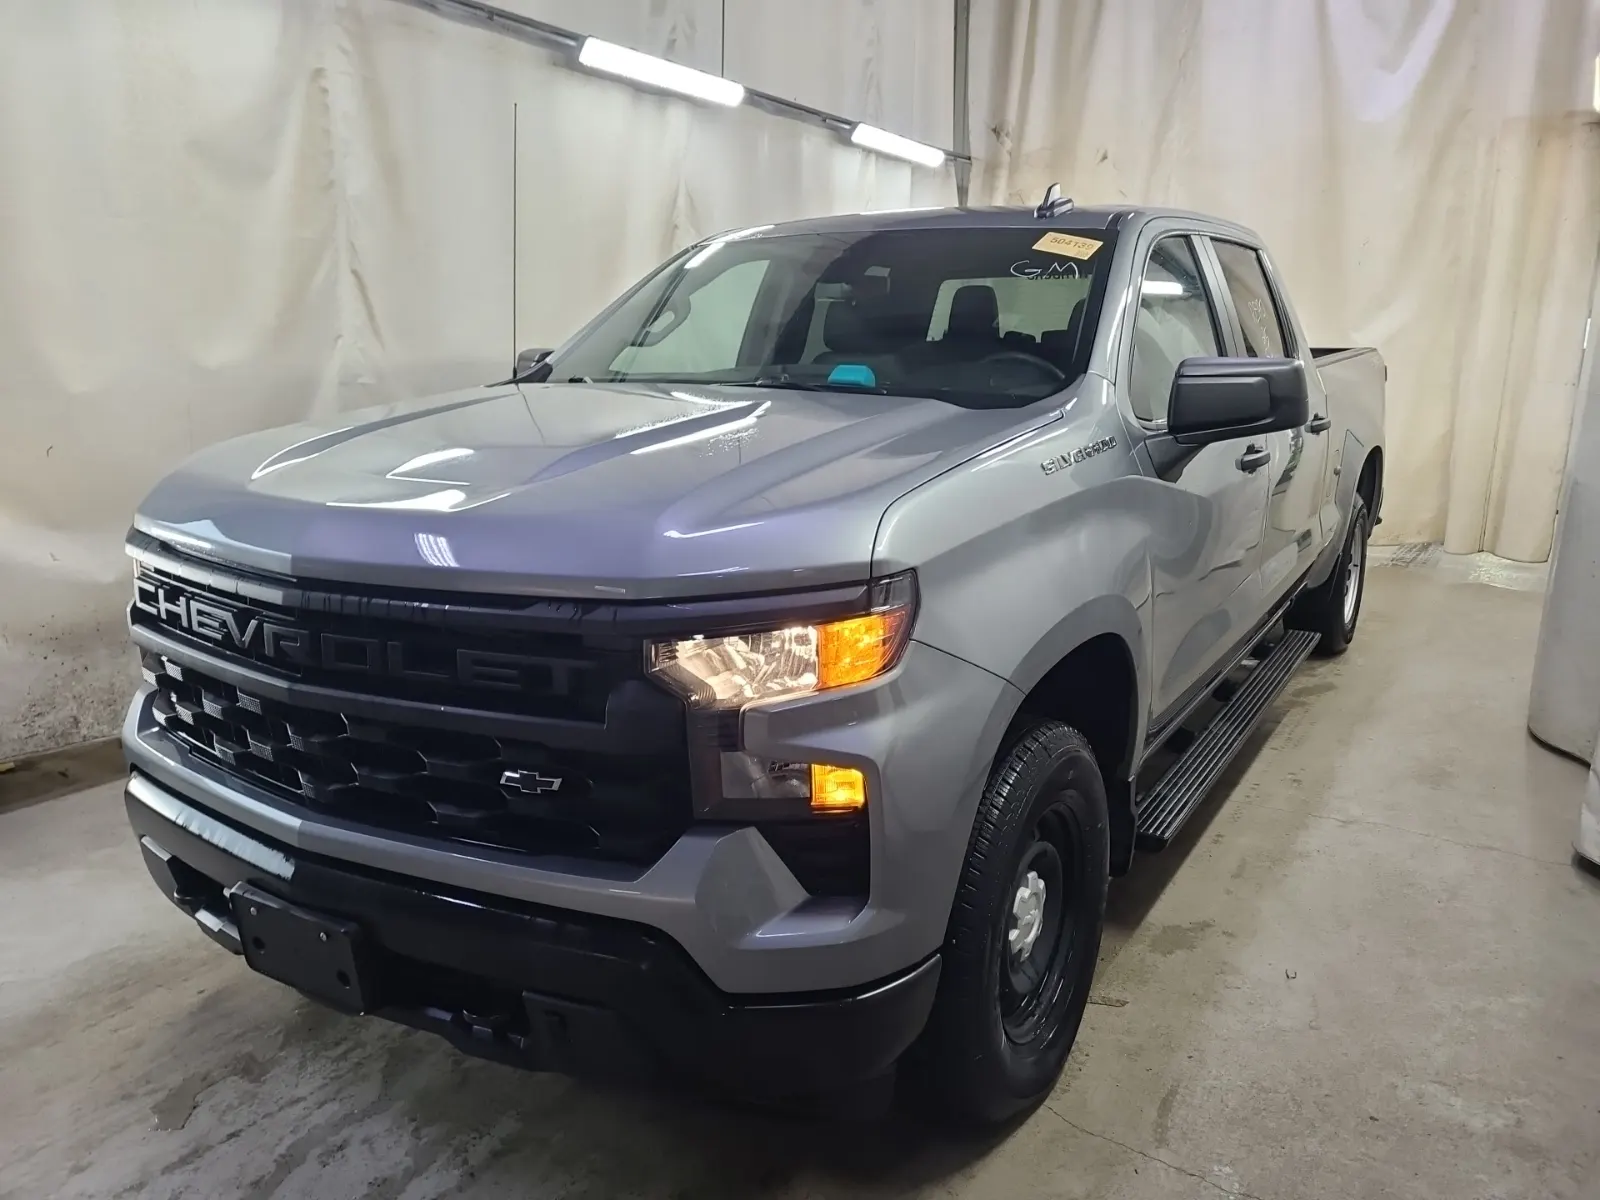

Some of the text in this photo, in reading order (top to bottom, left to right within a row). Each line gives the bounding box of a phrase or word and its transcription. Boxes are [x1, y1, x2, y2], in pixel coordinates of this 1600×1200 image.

[1050, 236, 1094, 251] 504139
[1010, 260, 1079, 279] GM
[132, 576, 597, 696] CHEVROLET
